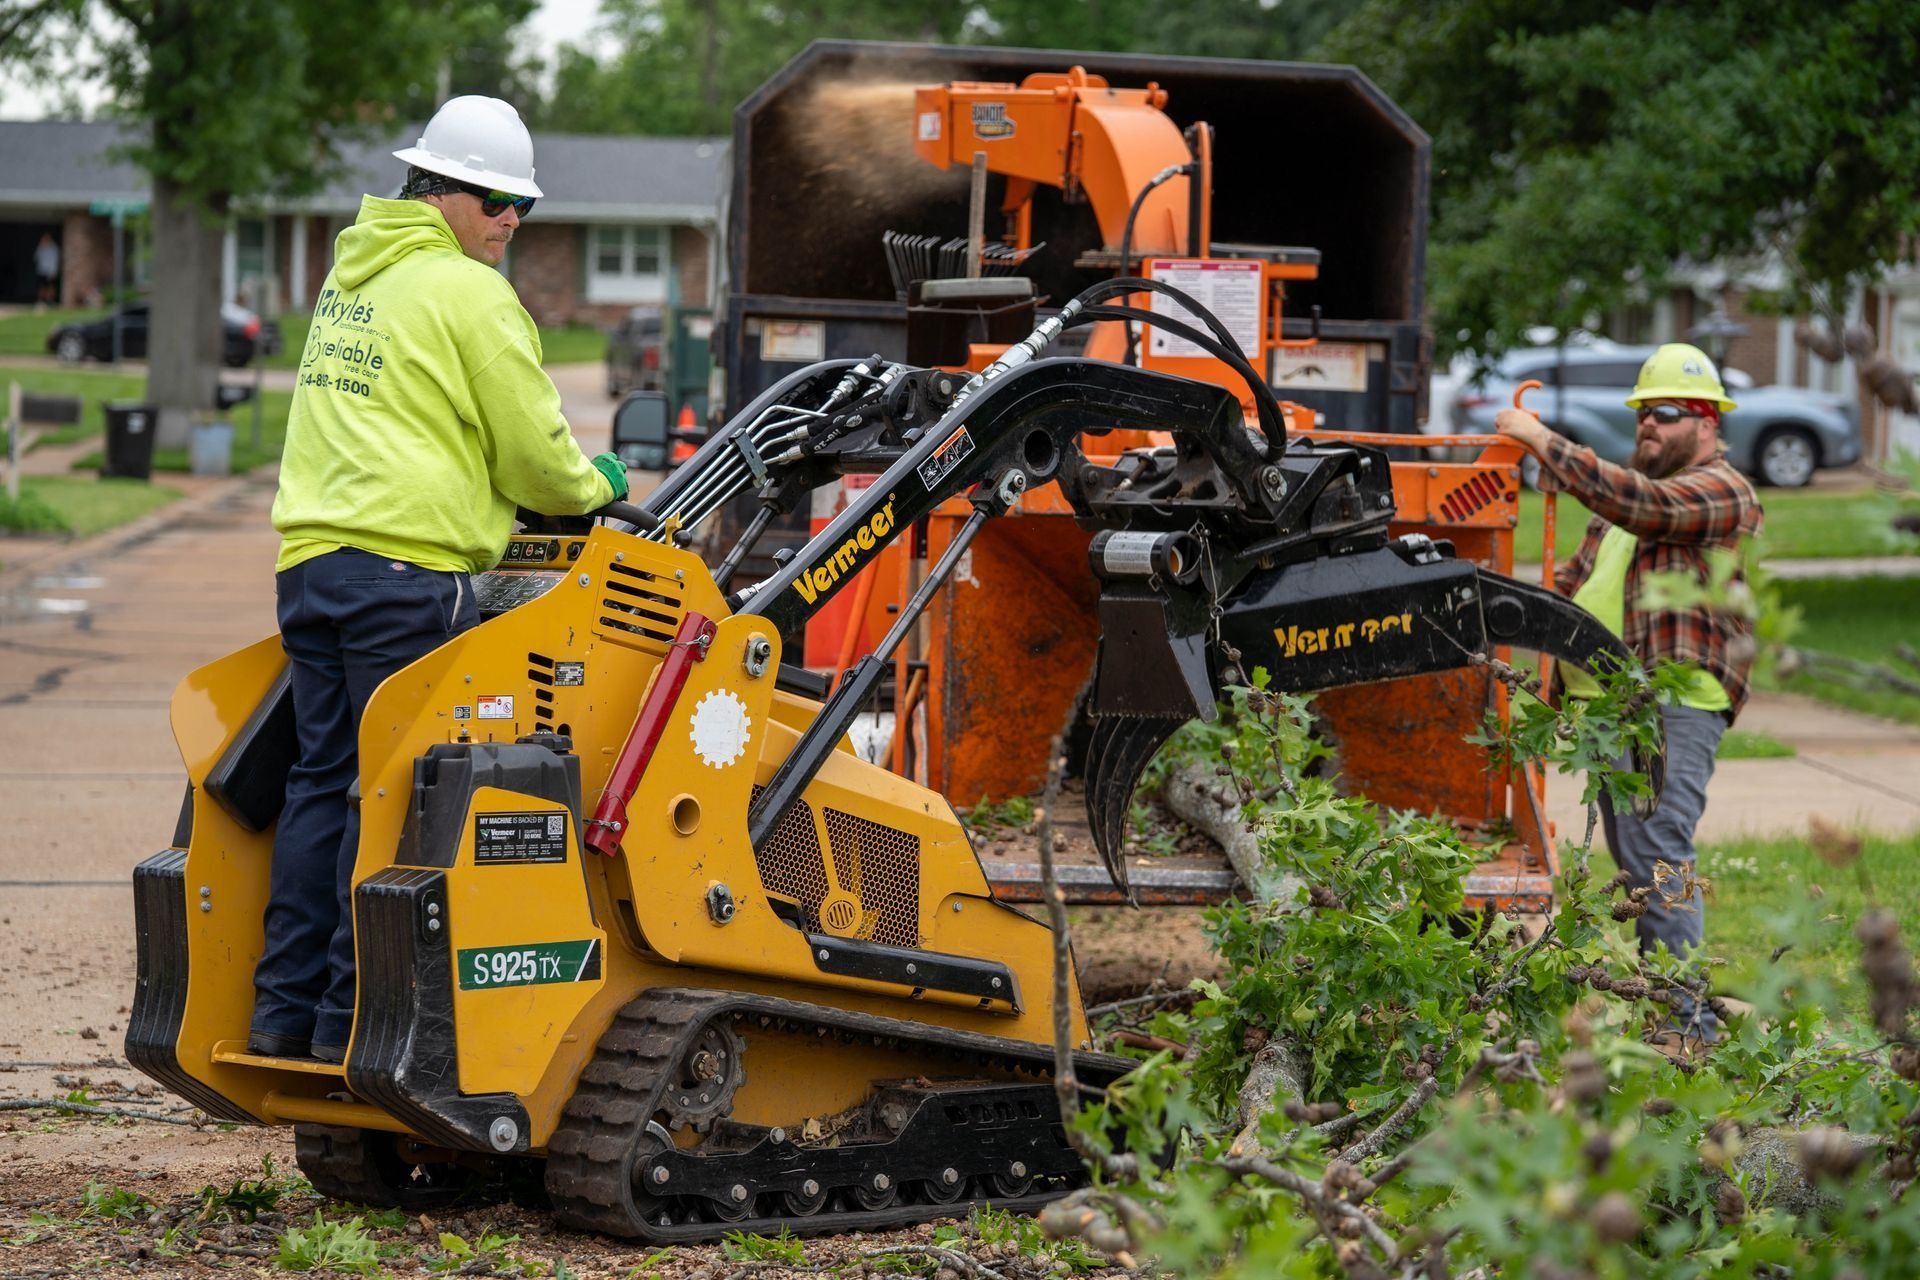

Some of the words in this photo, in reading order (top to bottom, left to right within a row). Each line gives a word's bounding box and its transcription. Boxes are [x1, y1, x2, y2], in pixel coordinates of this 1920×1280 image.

[327, 290, 374, 326] kyle's
[366, 326, 390, 342] service
[322, 336, 383, 370] reliable
[344, 364, 360, 374] tree
[361, 368, 379, 380] care
[791, 501, 895, 605] Vermeer
